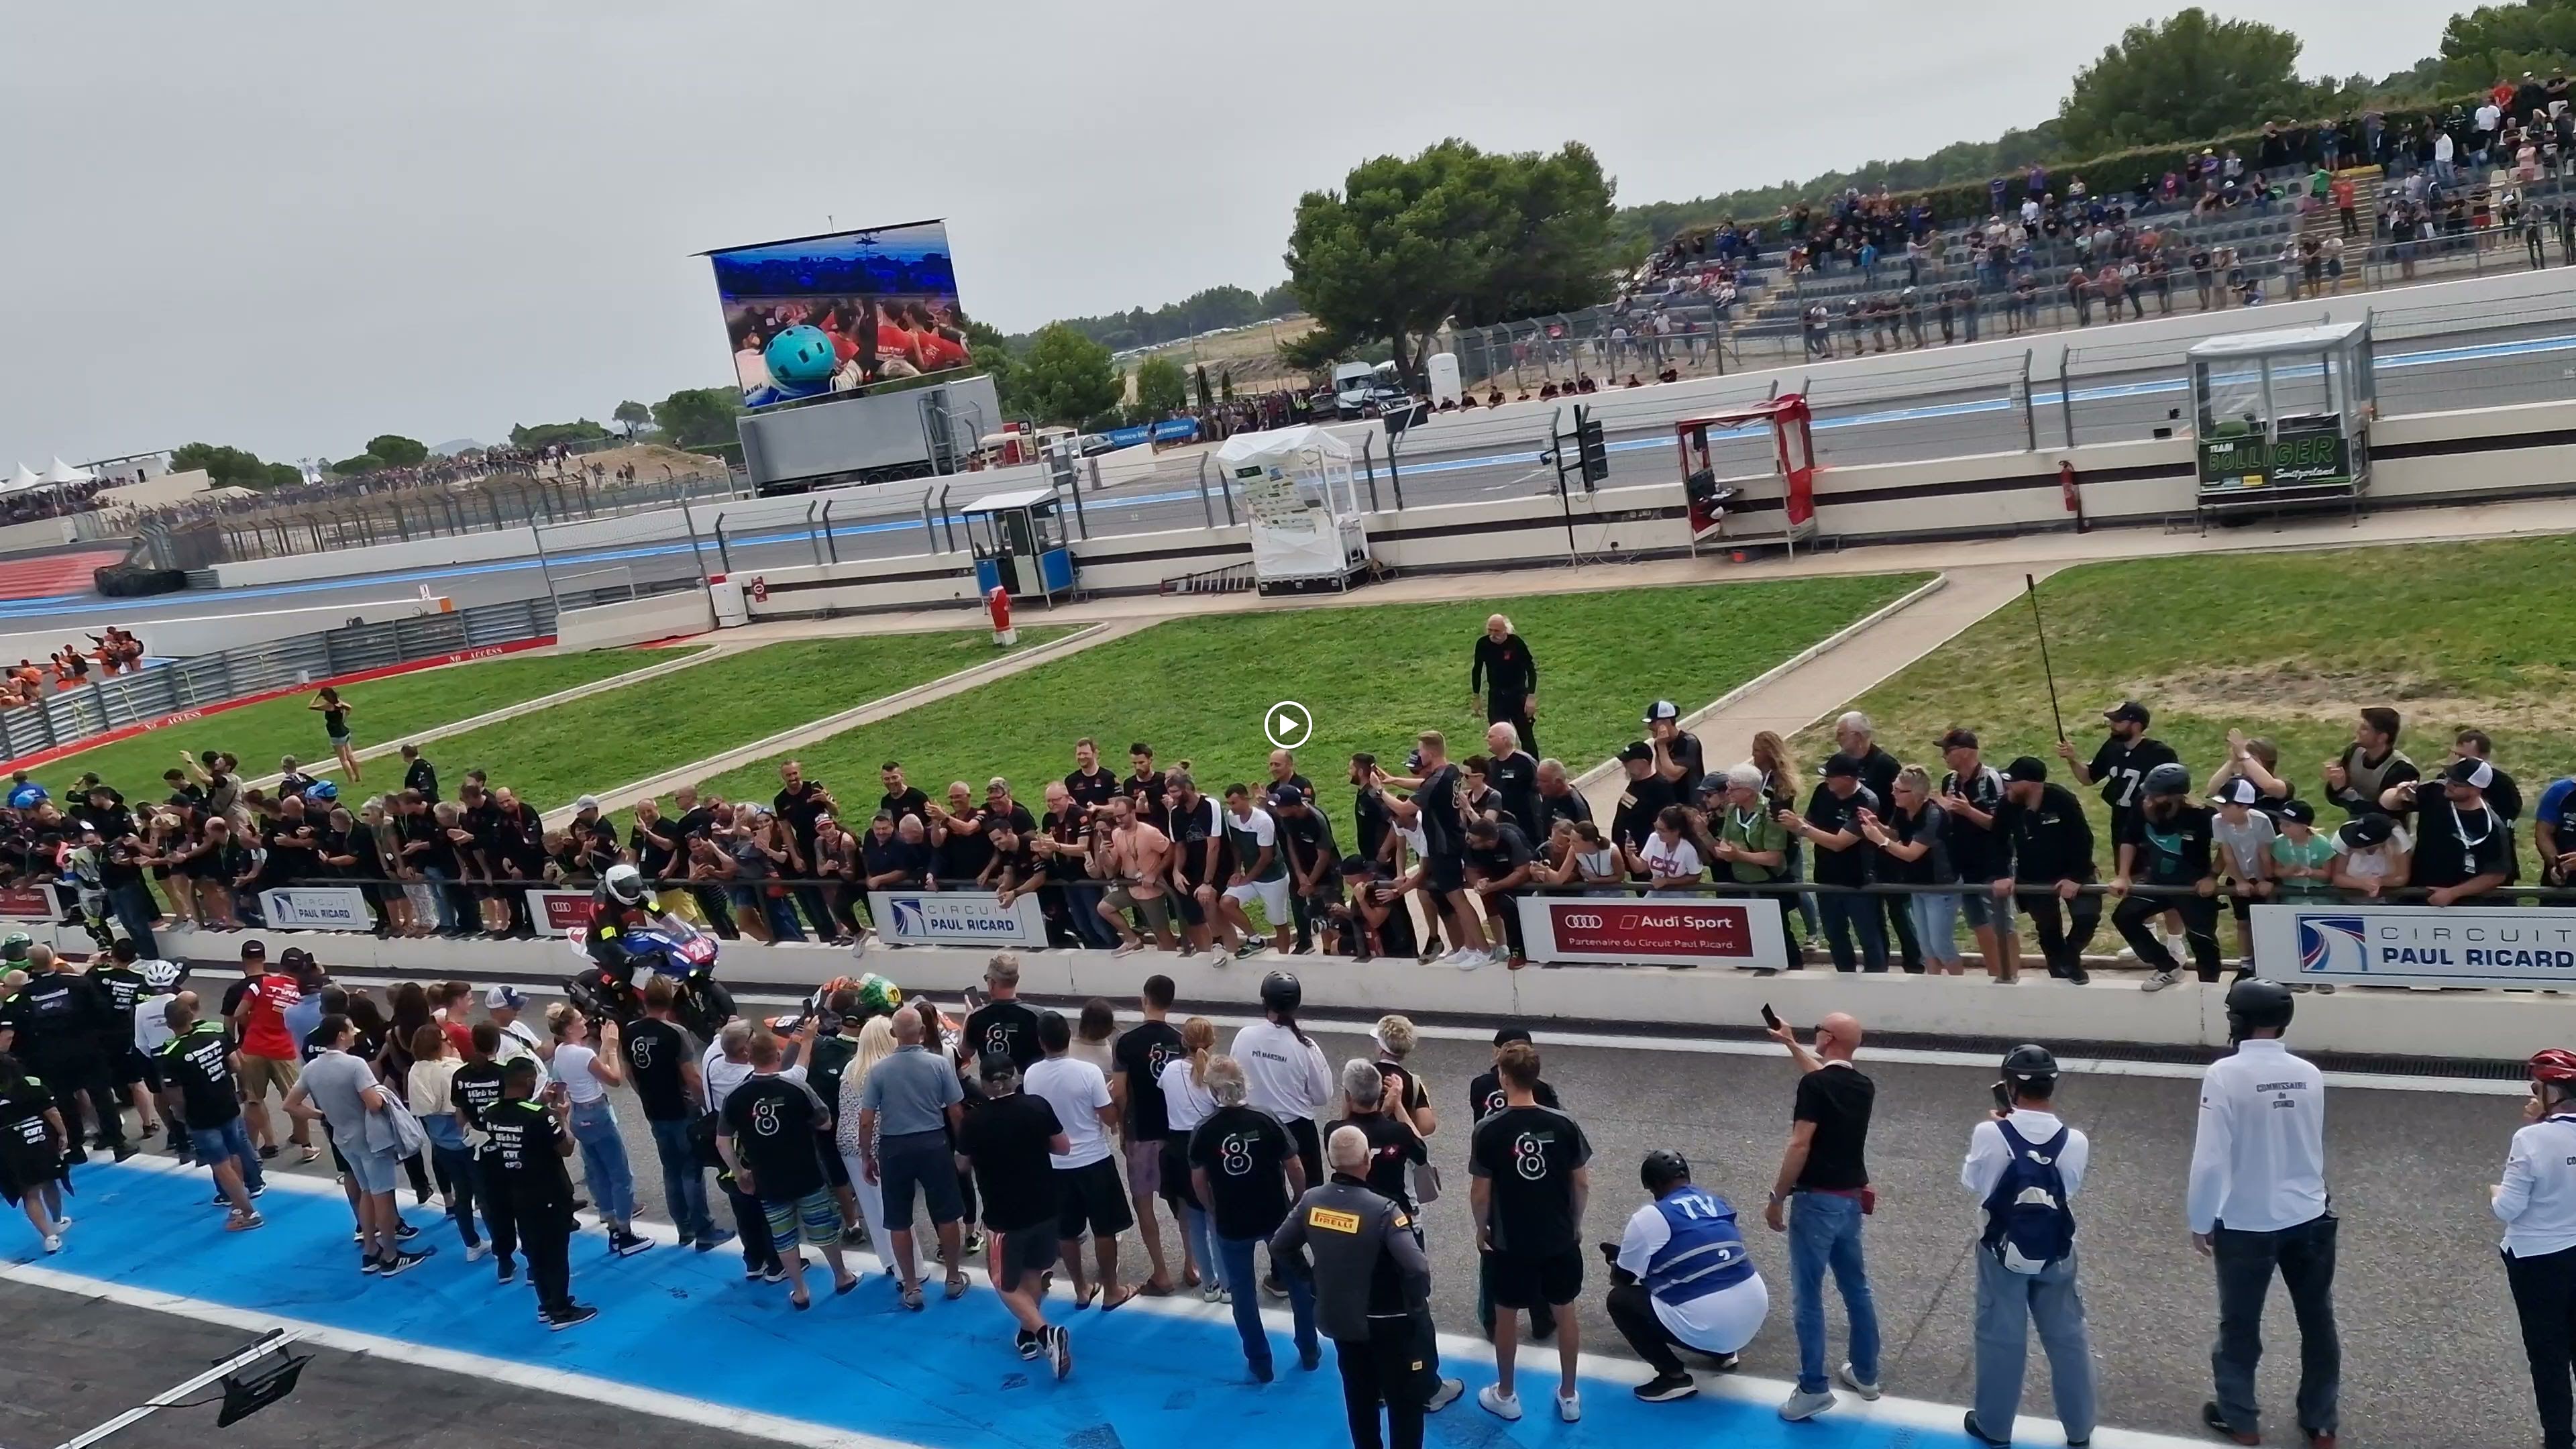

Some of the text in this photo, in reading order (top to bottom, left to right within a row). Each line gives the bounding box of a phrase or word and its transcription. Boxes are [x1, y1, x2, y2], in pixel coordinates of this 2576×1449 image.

[2209, 443, 2234, 453] TEAM
[2209, 436, 2335, 470] BOLLIGER
[449, 647, 503, 663] NO ACCESS
[299, 909, 350, 918] PAUL RICARD
[931, 918, 1014, 931] PAUL RICARD
[1642, 916, 1733, 930] Audi Sport
[1623, 938, 1637, 947] du
[1639, 939, 1672, 947] Circuit
[1674, 940, 1697, 948] Paul
[2381, 927, 2571, 943] CIRCUIT
[2382, 947, 2574, 967] PAUL RICARD
[1262, 1053, 1287, 1063] MARSHAL
[753, 1098, 780, 1134] 8
[1222, 1134, 1252, 1175] 8
[1515, 1132, 1546, 1180] 8
[1670, 1195, 1718, 1220] TV
[1314, 1212, 1354, 1229] PIRELLI
